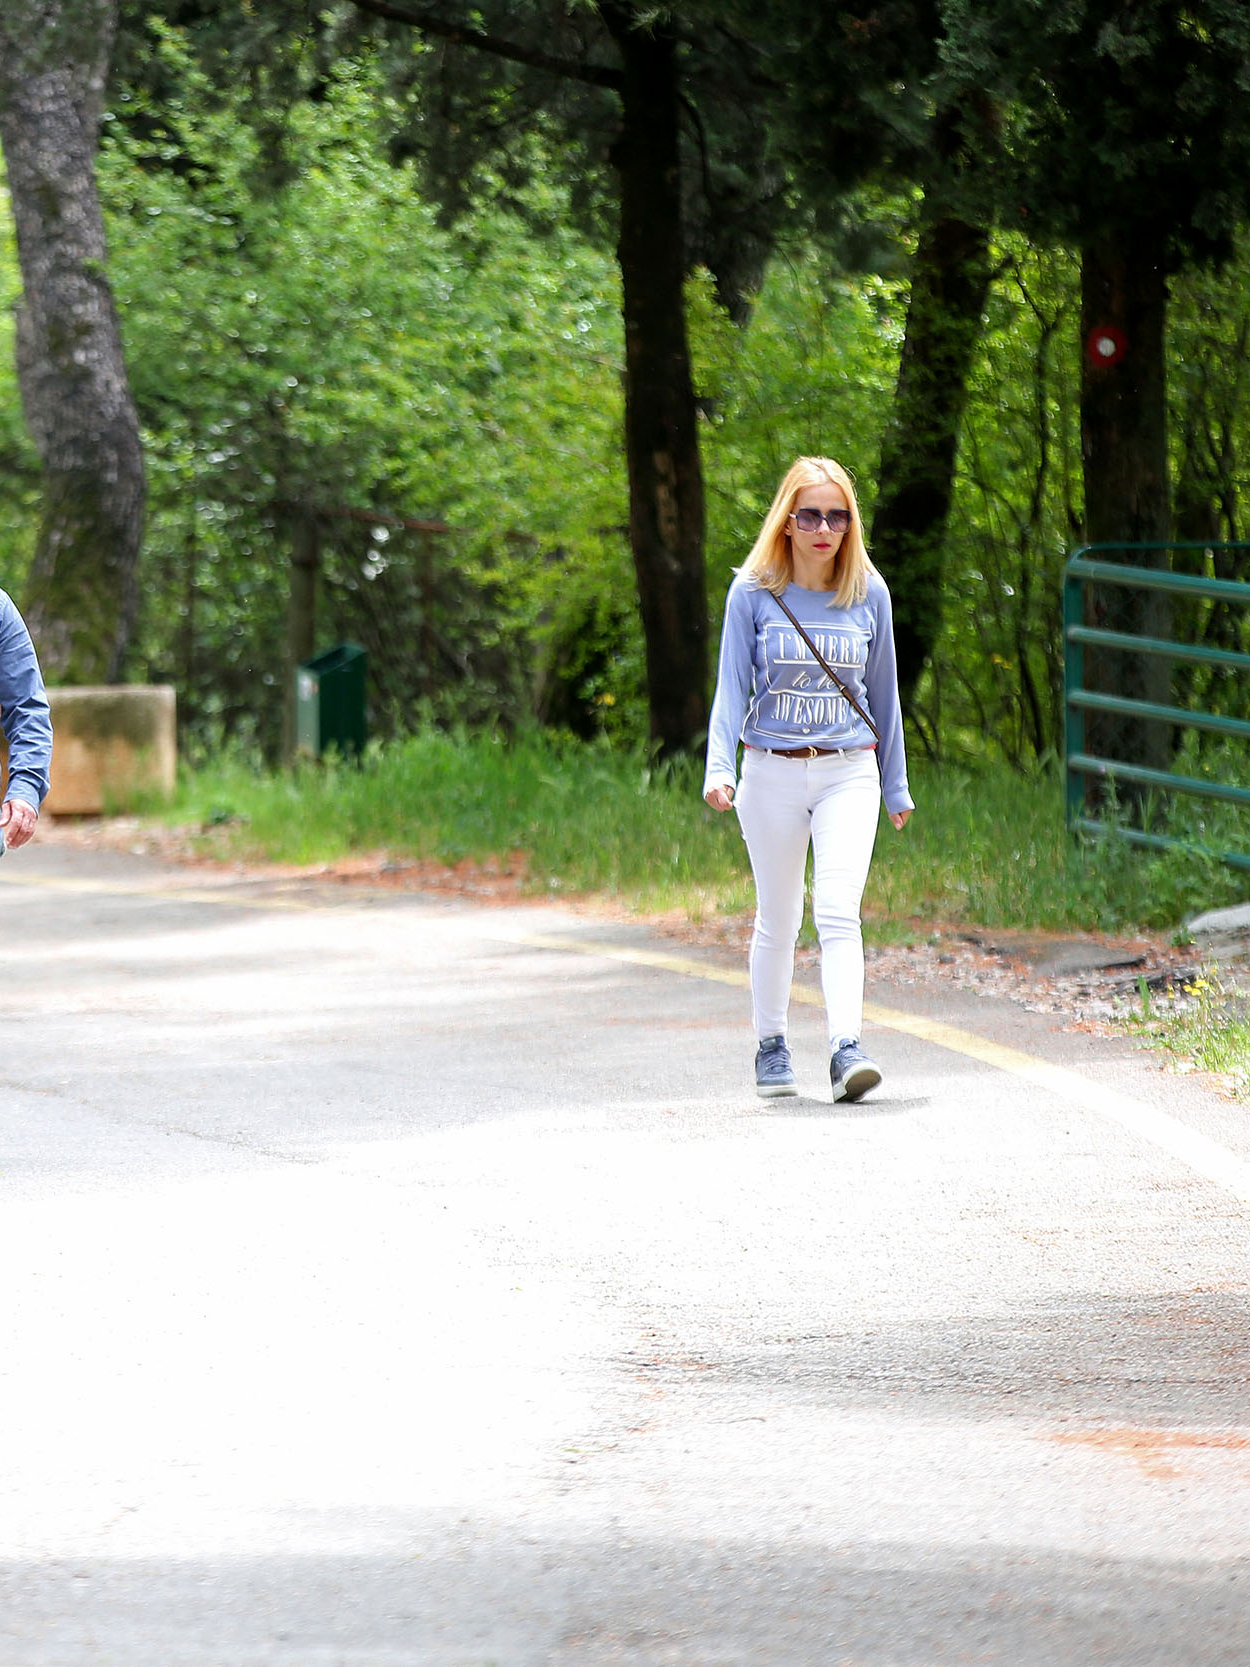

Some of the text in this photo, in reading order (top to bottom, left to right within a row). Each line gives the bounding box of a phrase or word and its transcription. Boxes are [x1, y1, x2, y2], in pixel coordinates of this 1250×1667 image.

[814, 633, 860, 664] HERE
[792, 671, 812, 689] to
[771, 694, 848, 726] AWESOME
